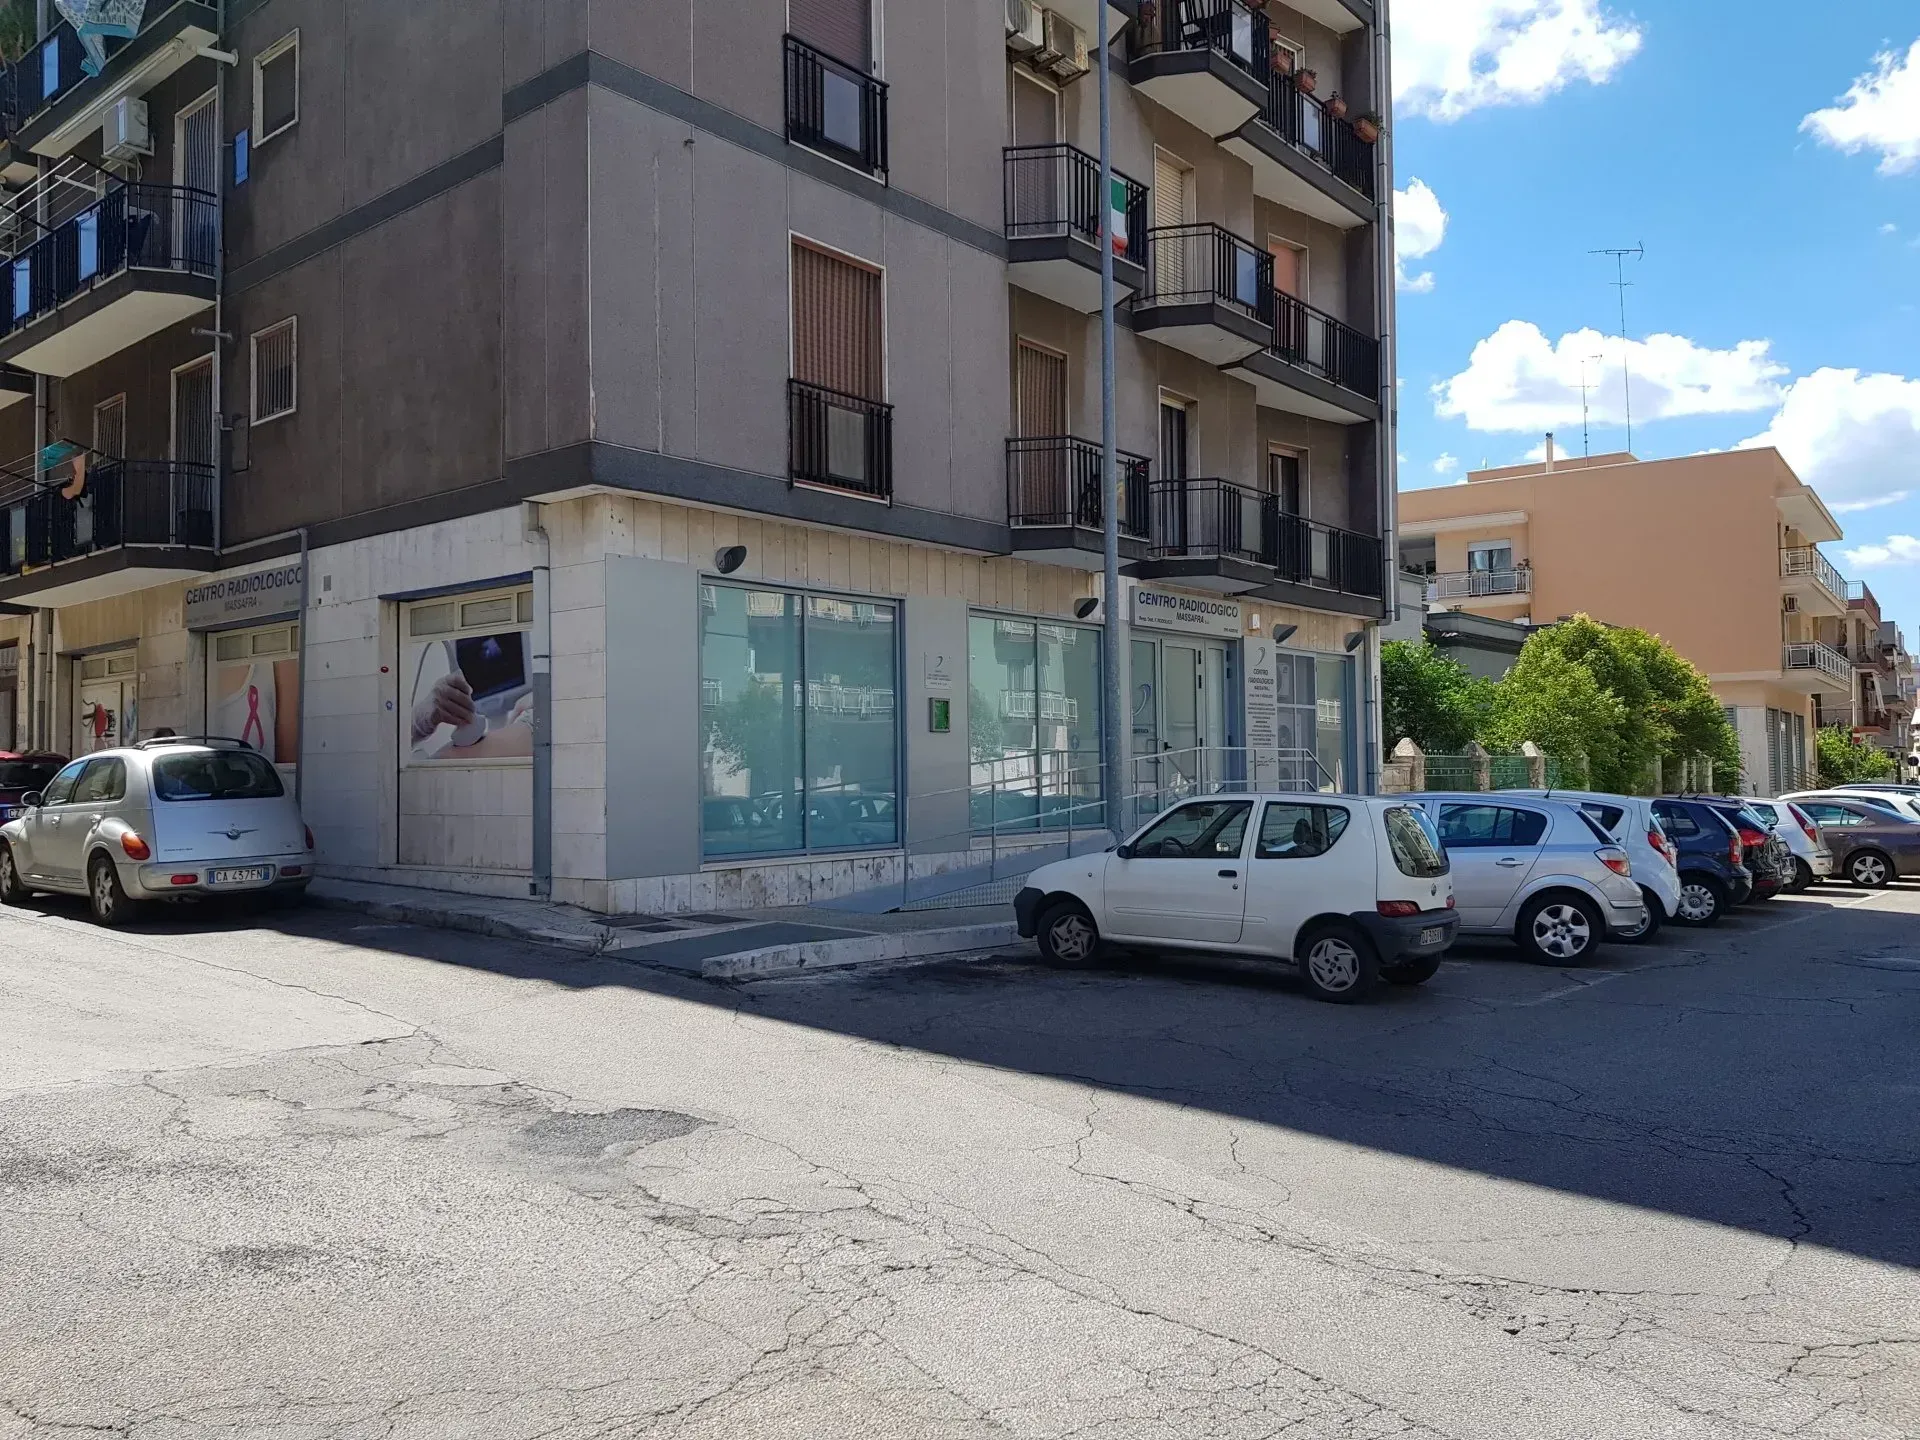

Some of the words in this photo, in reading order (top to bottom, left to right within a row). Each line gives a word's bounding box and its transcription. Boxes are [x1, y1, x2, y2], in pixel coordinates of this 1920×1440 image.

[186, 583, 225, 605] CENTRO
[224, 596, 257, 612] MASSAFRA
[1138, 591, 1177, 609] CENTRO
[1179, 598, 1239, 618] RADIOLOGICO
[1176, 612, 1205, 624] MASSAFRA
[216, 871, 228, 882] CA
[232, 868, 263, 881] 437FN
